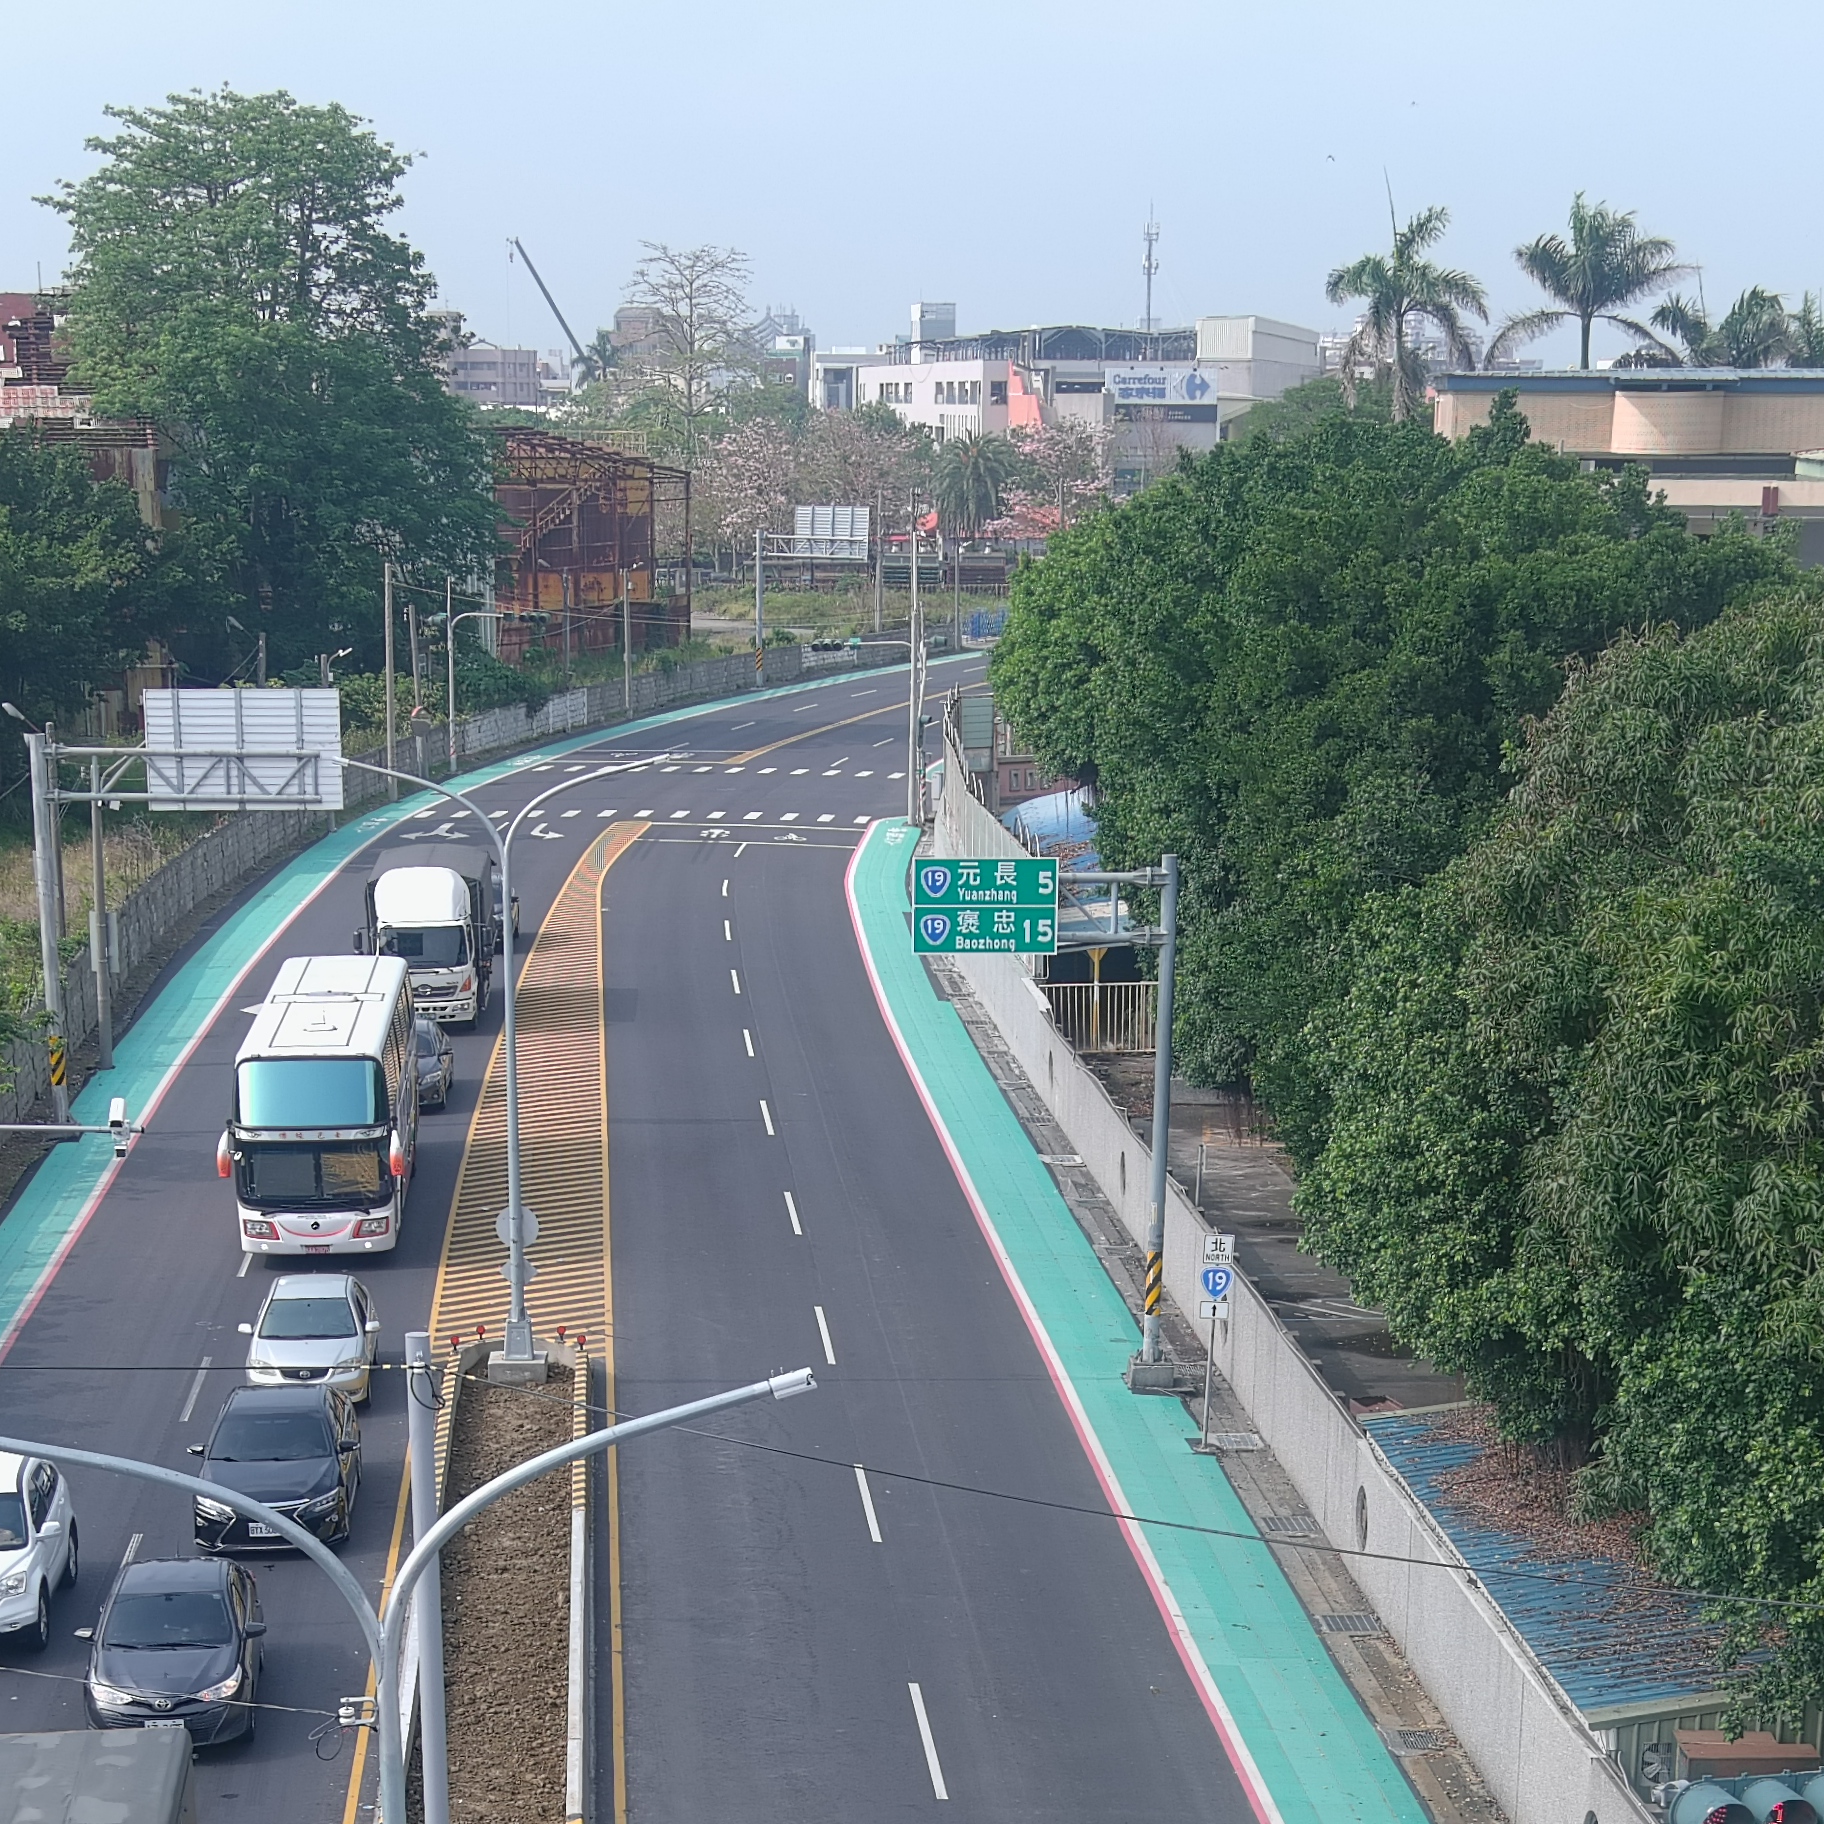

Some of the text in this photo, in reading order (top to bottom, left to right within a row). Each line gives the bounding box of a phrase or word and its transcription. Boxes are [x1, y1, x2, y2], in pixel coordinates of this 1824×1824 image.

[1113, 374, 1166, 386] Carrefour
[926, 871, 944, 886] 19
[957, 861, 1017, 886] 元長
[1038, 871, 1054, 895] 5
[957, 888, 1017, 904] Yuanzhang
[926, 919, 944, 934] 19
[957, 910, 1016, 934] 褒忠
[1023, 919, 1053, 943] 15
[955, 936, 1016, 952] Baozhong
[1211, 1238, 1226, 1252] 北
[1205, 1253, 1230, 1262] NORTH
[1208, 1271, 1227, 1290] 19
